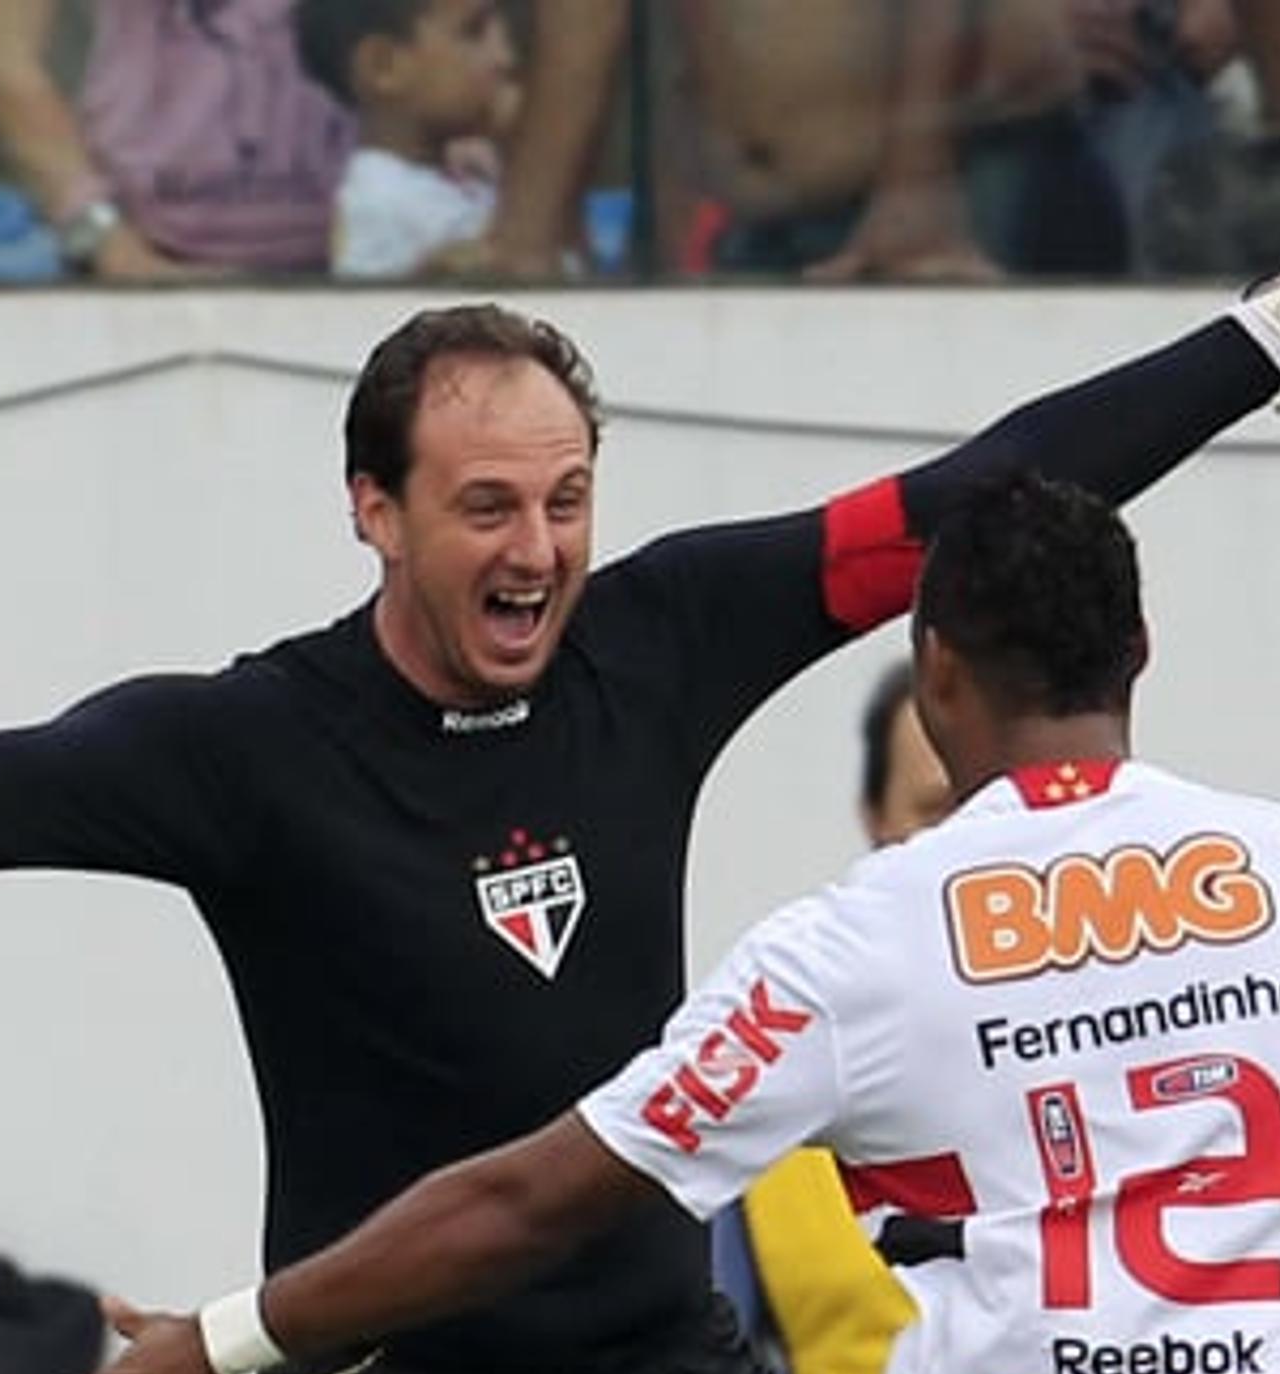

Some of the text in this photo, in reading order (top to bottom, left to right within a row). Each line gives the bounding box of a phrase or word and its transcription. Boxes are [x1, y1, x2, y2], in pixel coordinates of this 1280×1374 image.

[487, 868, 574, 912] SPFC
[946, 832, 1275, 986] BMG
[641, 977, 812, 1154] FISK
